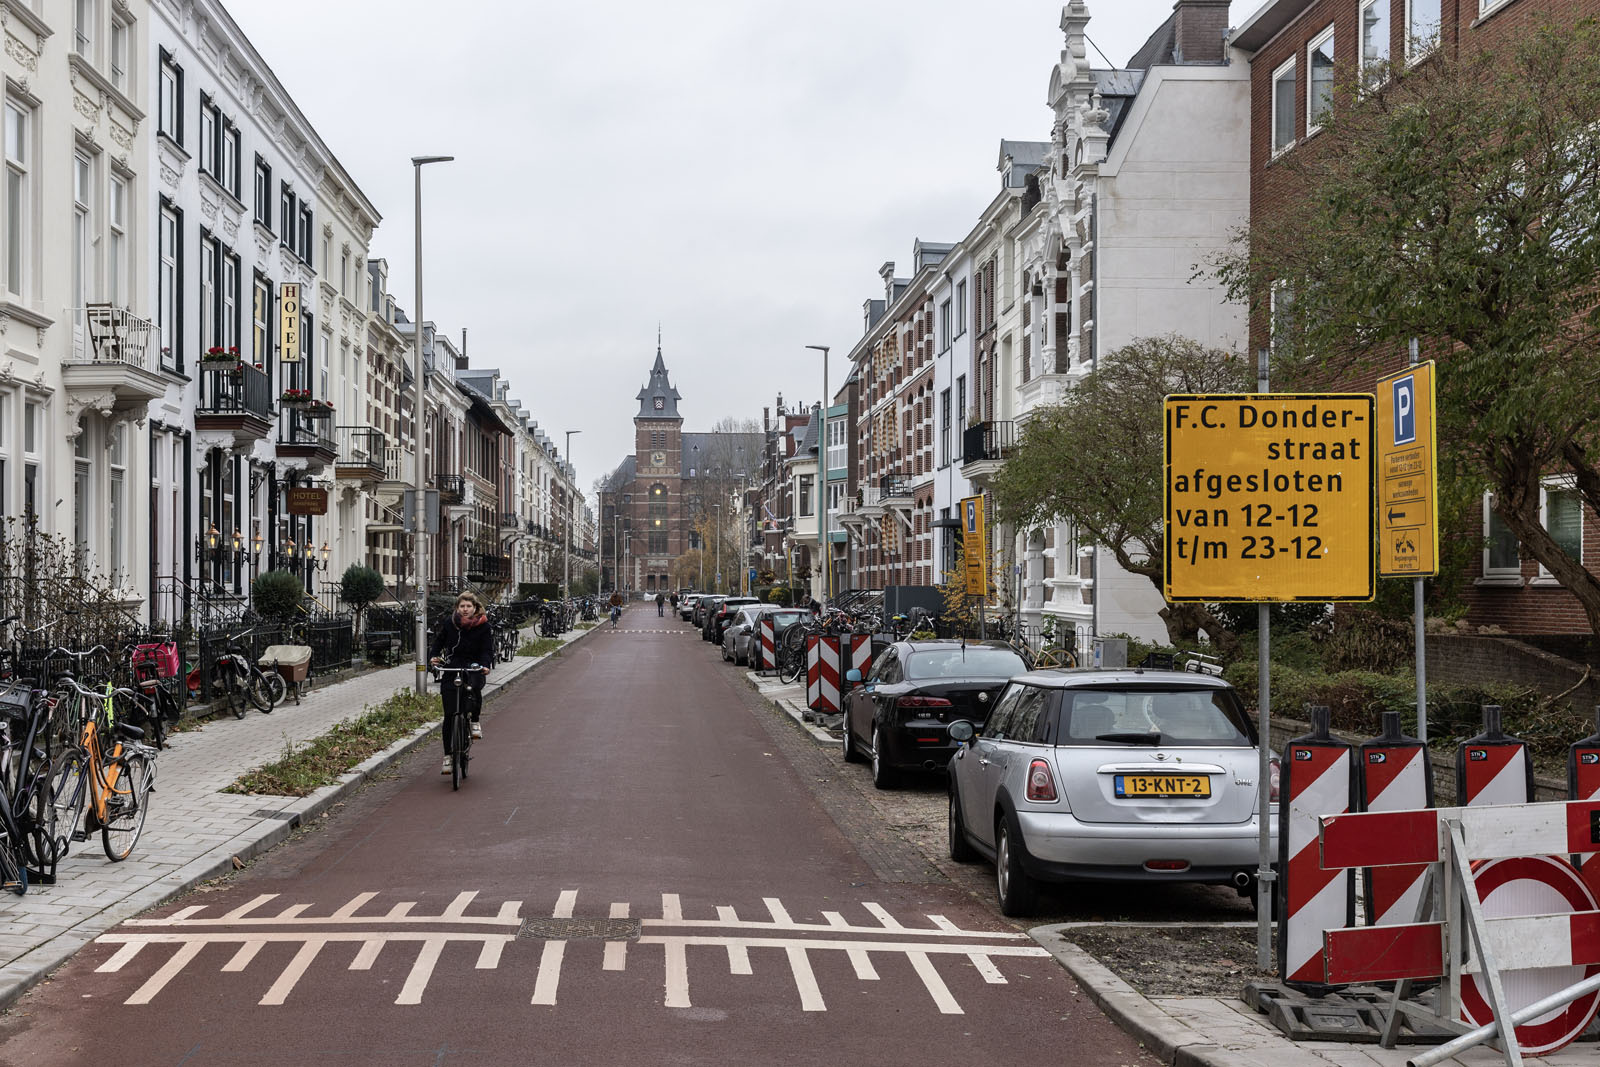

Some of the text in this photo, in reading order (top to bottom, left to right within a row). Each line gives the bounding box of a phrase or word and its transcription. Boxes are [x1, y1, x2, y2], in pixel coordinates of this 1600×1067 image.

[285, 285, 296, 360] HOTEL
[1175, 404, 1364, 429] F.C. Donder-
[1399, 386, 1410, 435] P
[1267, 438, 1361, 460] straat
[294, 492, 320, 500] HOTEL
[1174, 468, 1343, 499] afgesloten
[1176, 503, 1319, 528] van 12-12
[1176, 535, 1323, 566] t/m 23-12
[1132, 778, 1202, 793] 13-KNT-2
